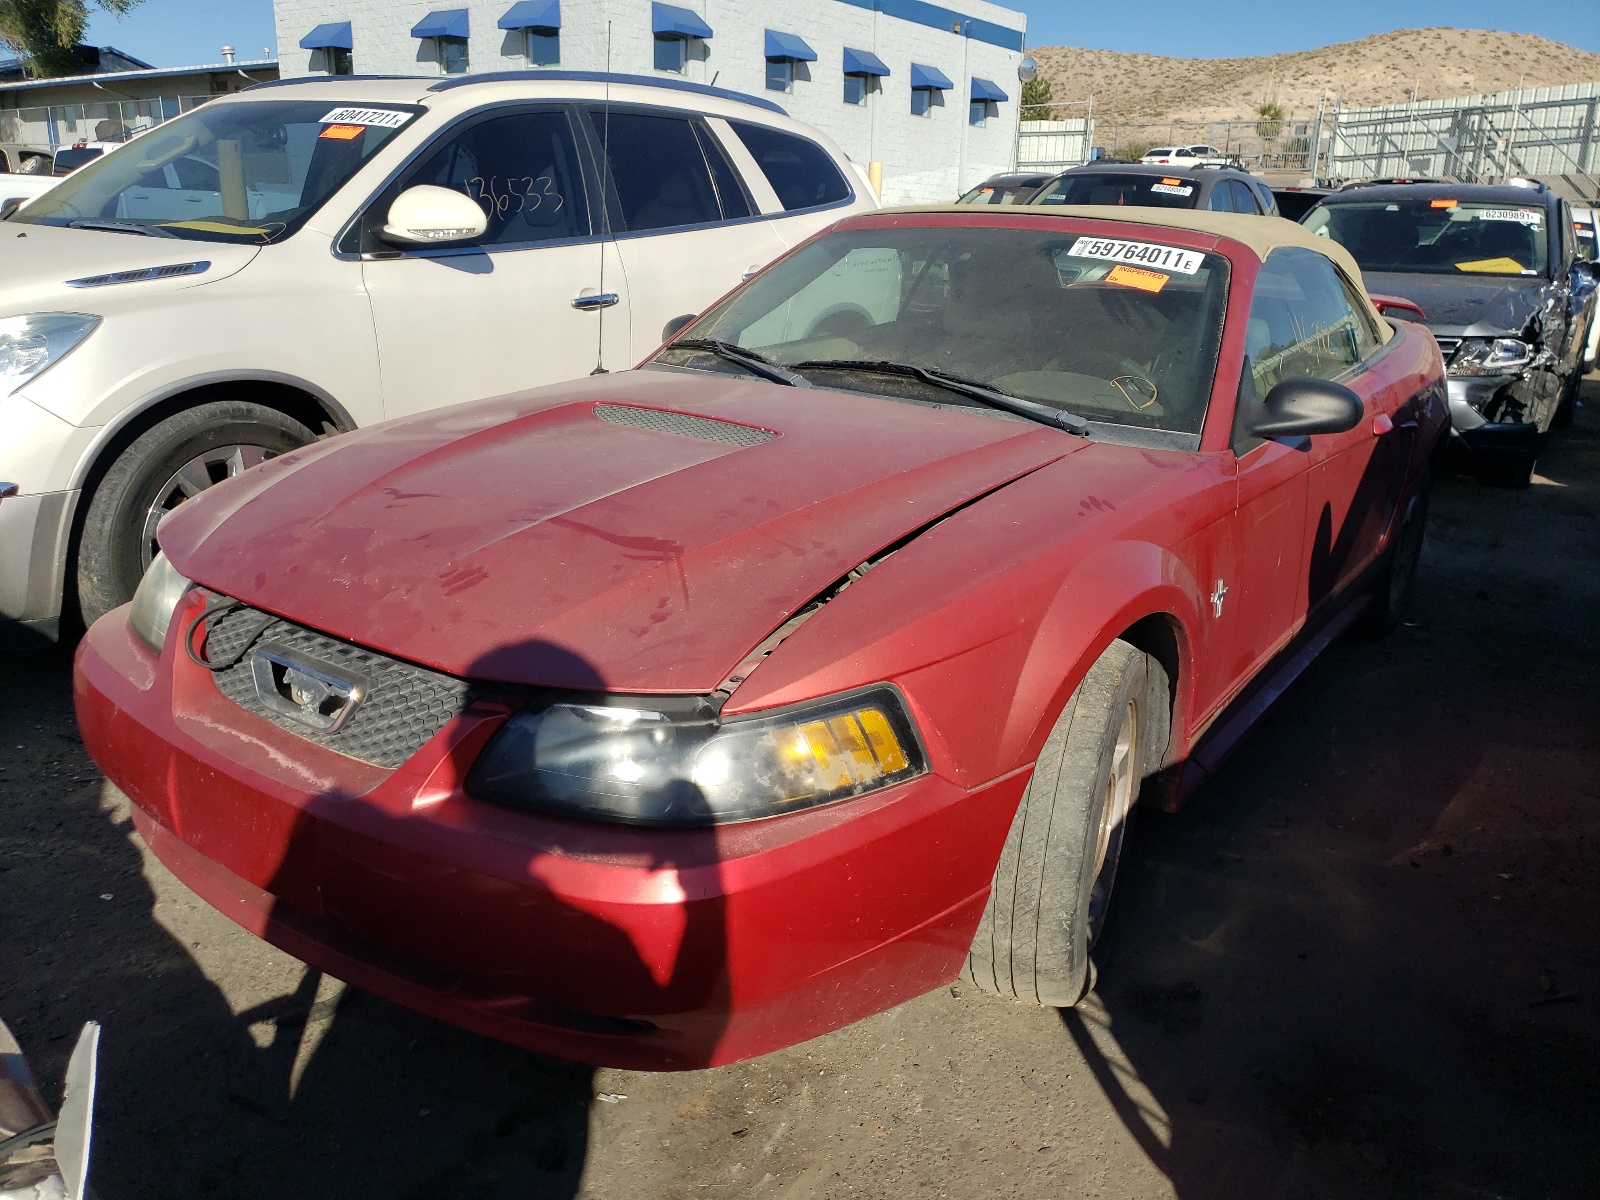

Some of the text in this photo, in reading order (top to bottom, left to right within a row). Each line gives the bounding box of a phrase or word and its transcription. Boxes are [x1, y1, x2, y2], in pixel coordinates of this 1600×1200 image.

[1156, 186, 1188, 194] 62148081
[464, 175, 564, 221] 136533
[1485, 210, 1535, 220] 62309891
[1118, 266, 1164, 280] INSPECTED
